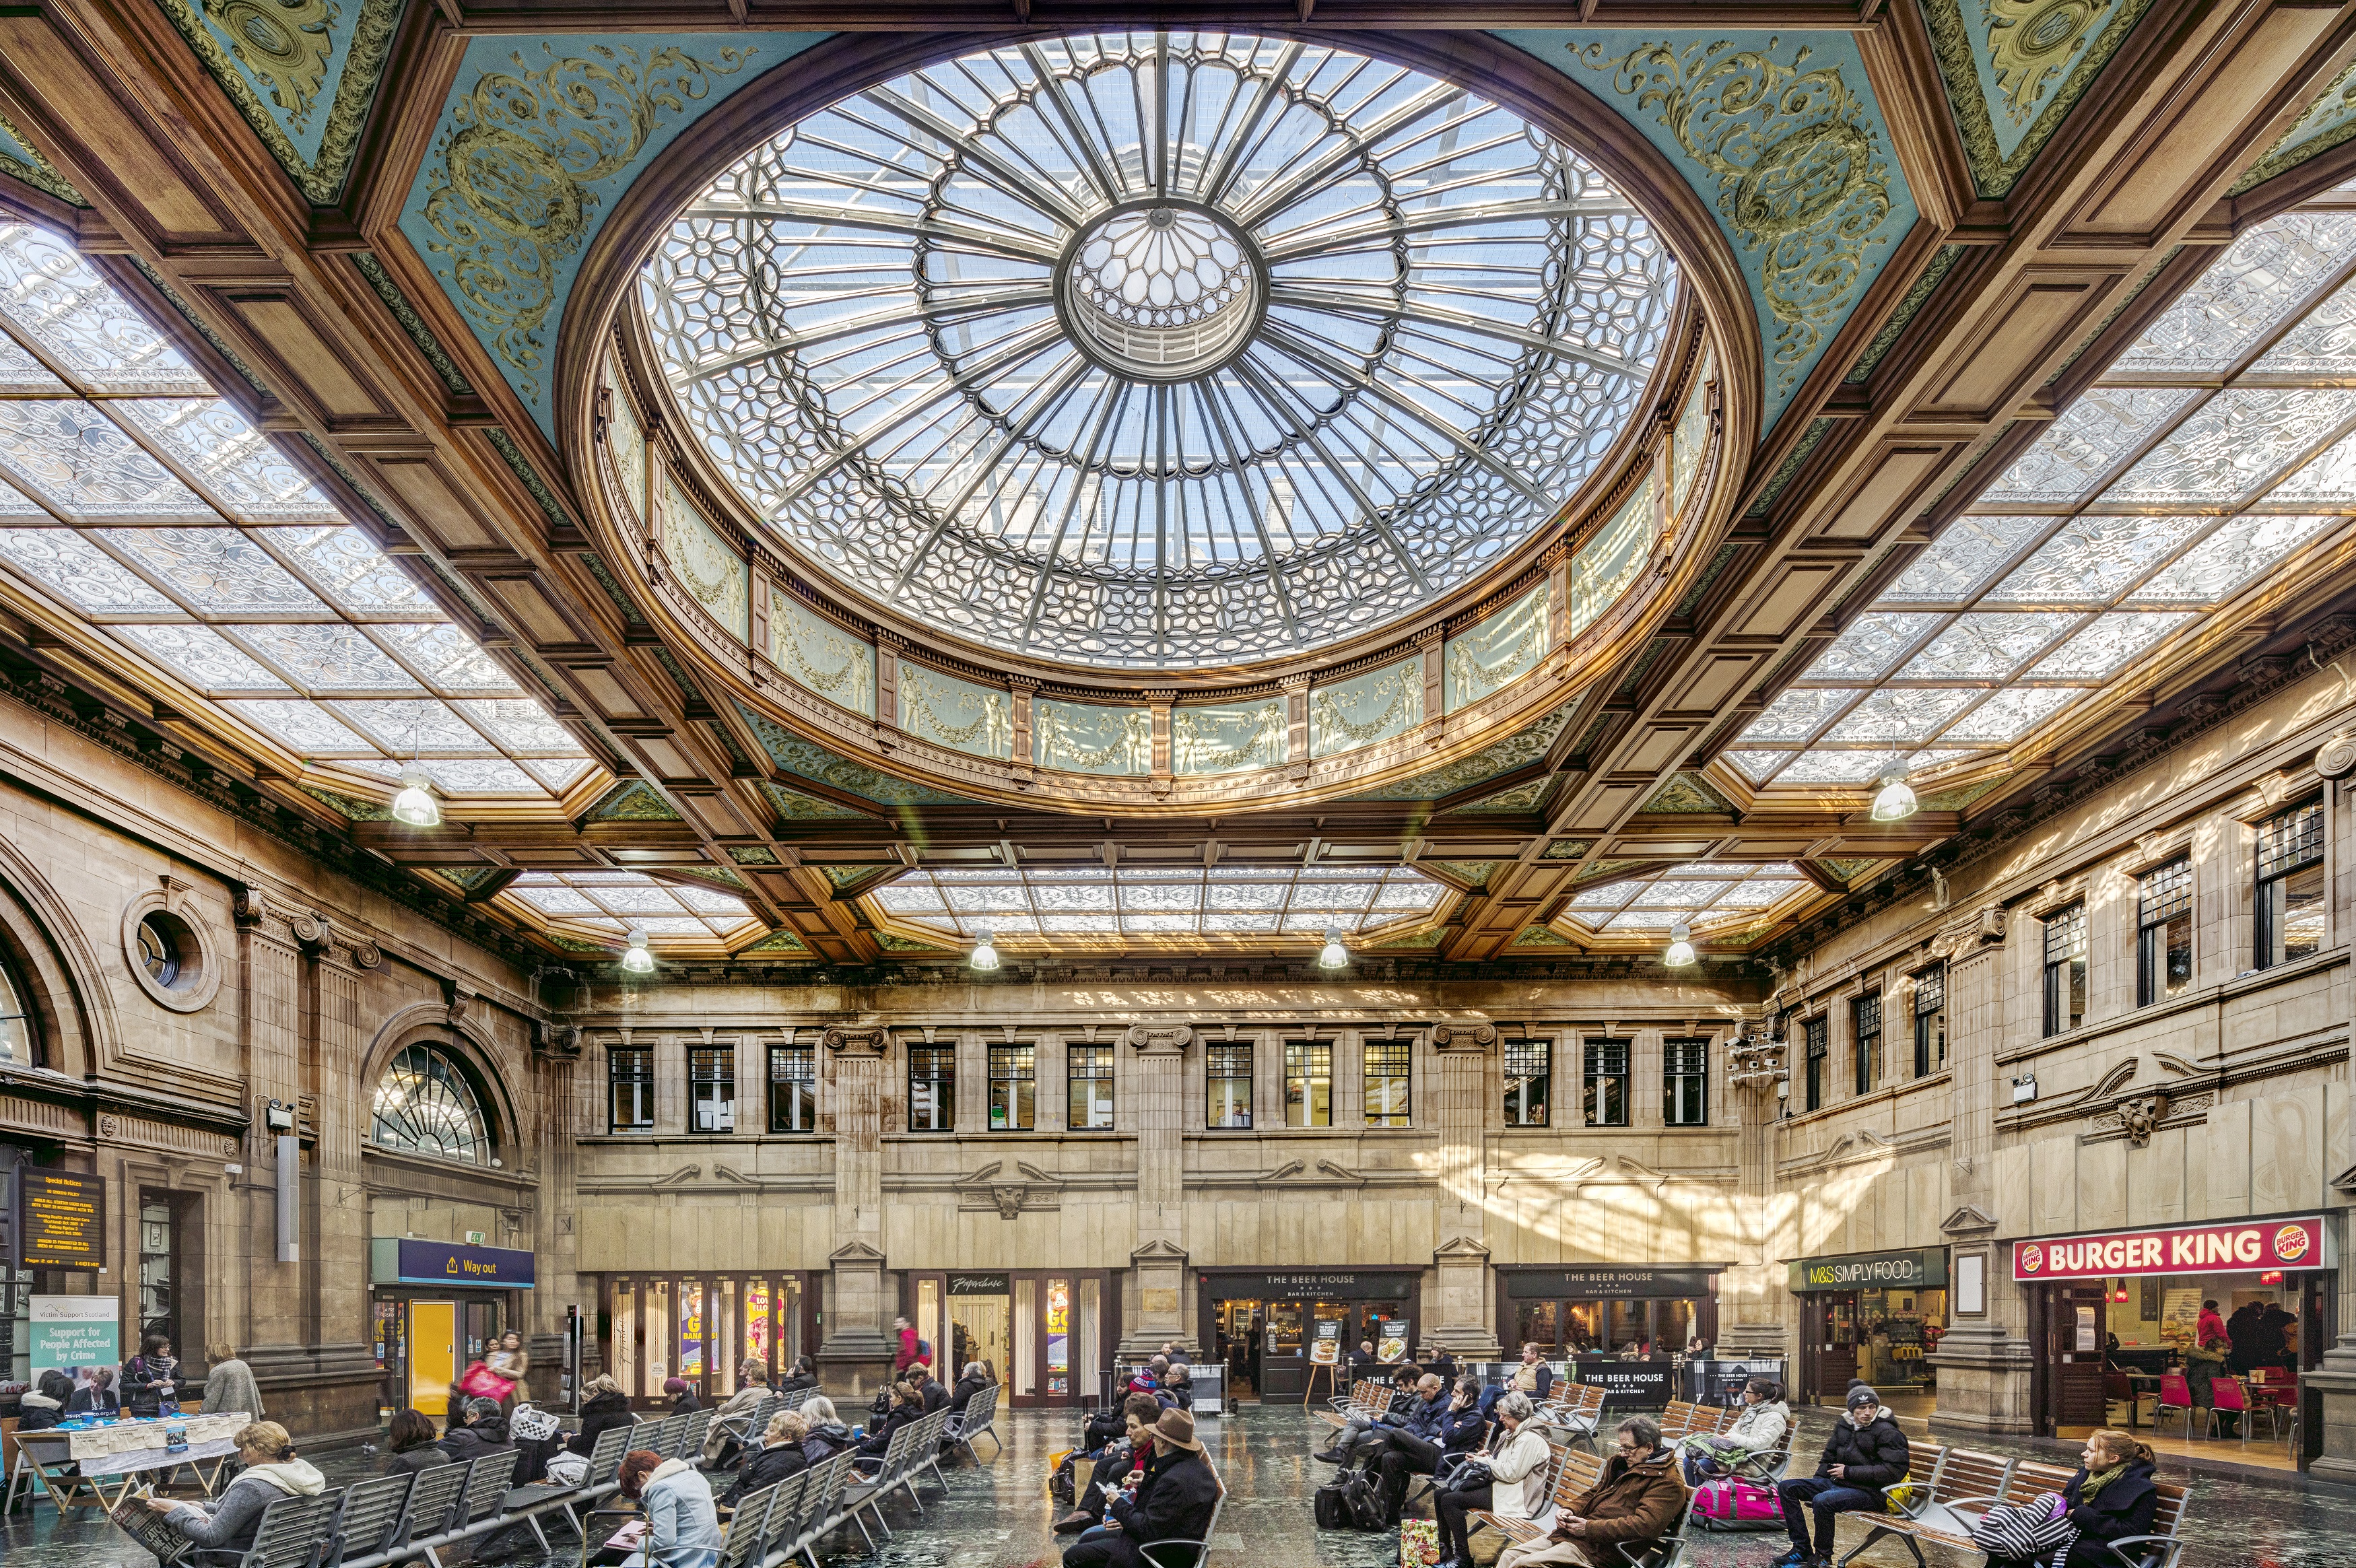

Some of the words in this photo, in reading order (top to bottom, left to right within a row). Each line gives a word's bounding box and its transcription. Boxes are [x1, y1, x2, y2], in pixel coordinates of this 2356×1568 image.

[2277, 1231, 2304, 1246] BURGER
[2278, 1237, 2305, 1255] KING
[2023, 1250, 2040, 1260] BURGER
[2050, 1237, 2162, 1270] BURGER
[2173, 1230, 2261, 1265] KING
[463, 1260, 481, 1275] Way
[483, 1263, 496, 1274] out
[2024, 1255, 2040, 1268] KING
[1321, 1275, 1354, 1283] HOUSE
[1811, 1266, 1833, 1283] M&S
[1836, 1263, 1873, 1283] SIMPLY
[1875, 1260, 1912, 1279] FOOD
[952, 1277, 1003, 1293] Paperchase
[49, 1328, 85, 1338] Support
[88, 1327, 100, 1336] for
[40, 1339, 70, 1351] People
[73, 1338, 110, 1348] Affected
[57, 1351, 67, 1363] by
[71, 1351, 95, 1360] Crime
[145, 1522, 166, 1542] CATCH
[152, 1537, 165, 1550] ME
[161, 1531, 170, 1541] IF
[160, 1542, 174, 1557] YOU
